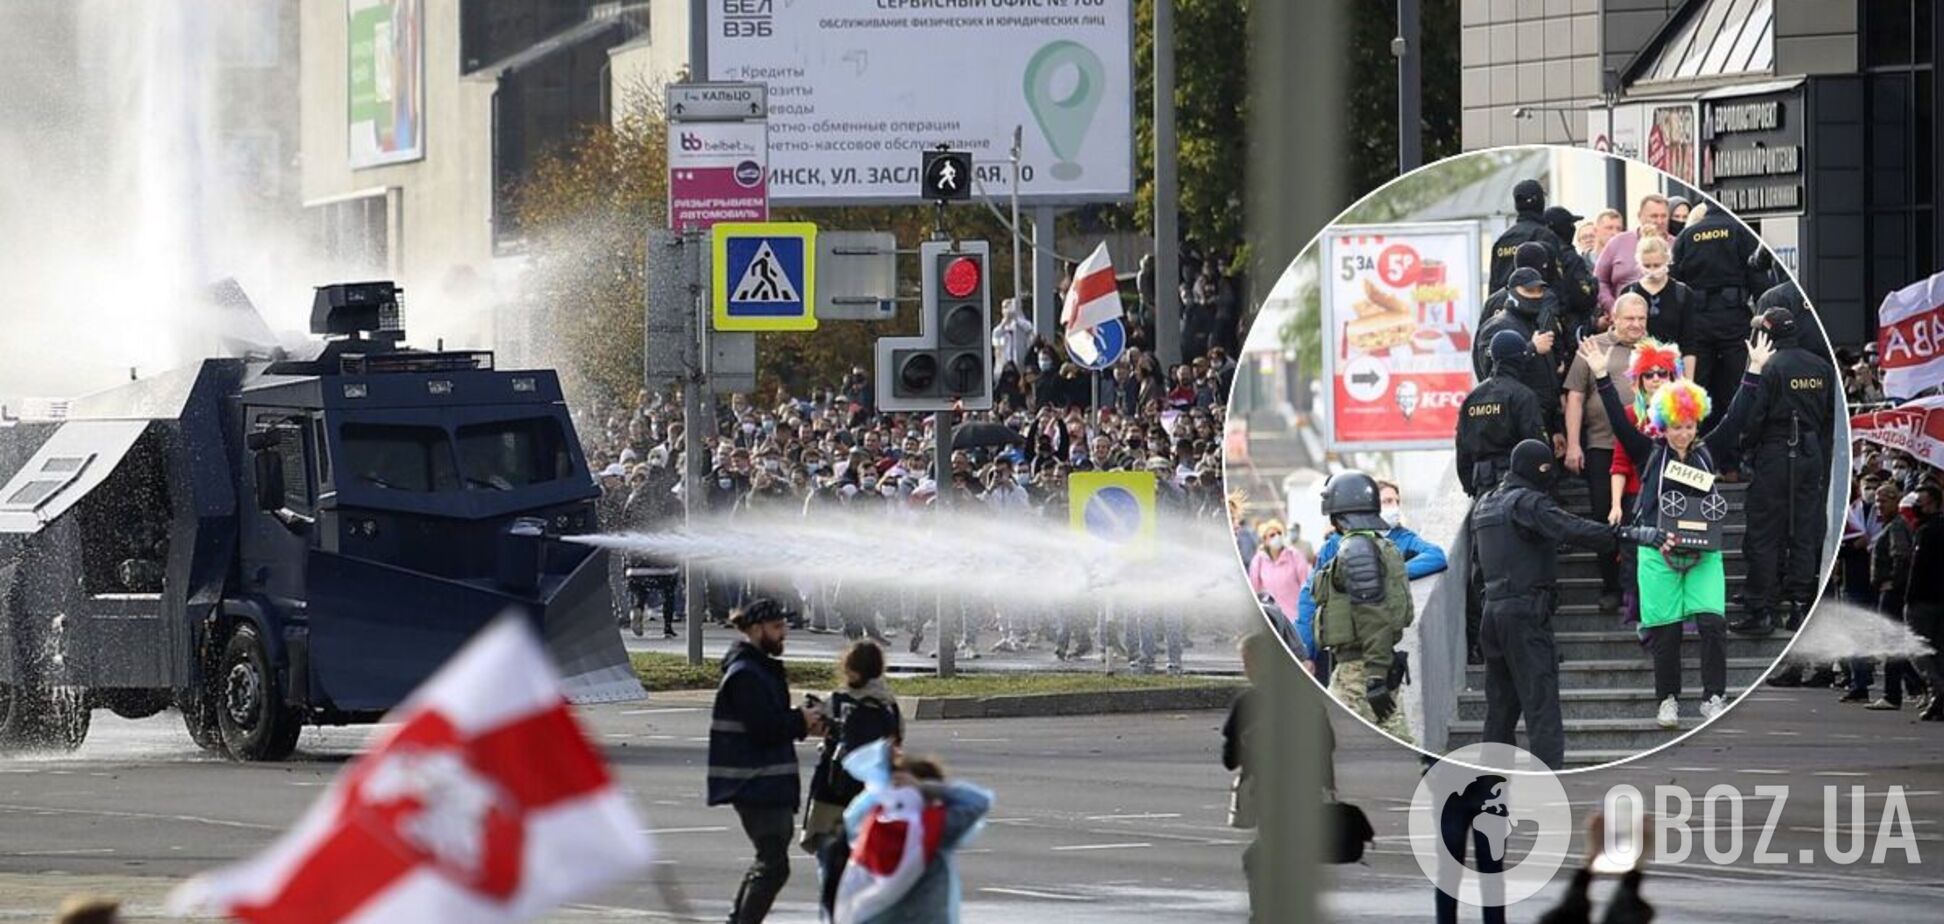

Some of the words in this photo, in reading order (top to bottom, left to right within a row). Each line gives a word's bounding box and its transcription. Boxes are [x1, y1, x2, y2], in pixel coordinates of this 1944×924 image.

[723, 0, 772, 14] БЕЛ
[723, 21, 773, 37] ВЭБ
[819, 18, 908, 29] ОБСЛУЖИВАНИЕ
[911, 17, 983, 28] ФИЗИЧЕСКИХ
[986, 17, 995, 27] И
[998, 16, 1079, 27] ЮРИДИЧЕСКИХ
[1081, 16, 1105, 27] ЛИЦ
[741, 66, 804, 79] Кредиты
[768, 85, 813, 97] озиты
[768, 104, 815, 116] еводы
[767, 119, 887, 133] ютно-обменные
[890, 119, 960, 133] операции
[767, 140, 881, 152] четно-кассовое
[768, 167, 826, 186] ИНСК,
[831, 166, 862, 184] УЛ.
[680, 209, 759, 220] АВТОМОБИЛЬ
[1693, 228, 1729, 242] ОМОН
[1497, 246, 1519, 258] ОМО
[1790, 378, 1824, 391] ОМОН
[1419, 391, 1467, 409] KFC
[1468, 404, 1501, 417] ОМОН
